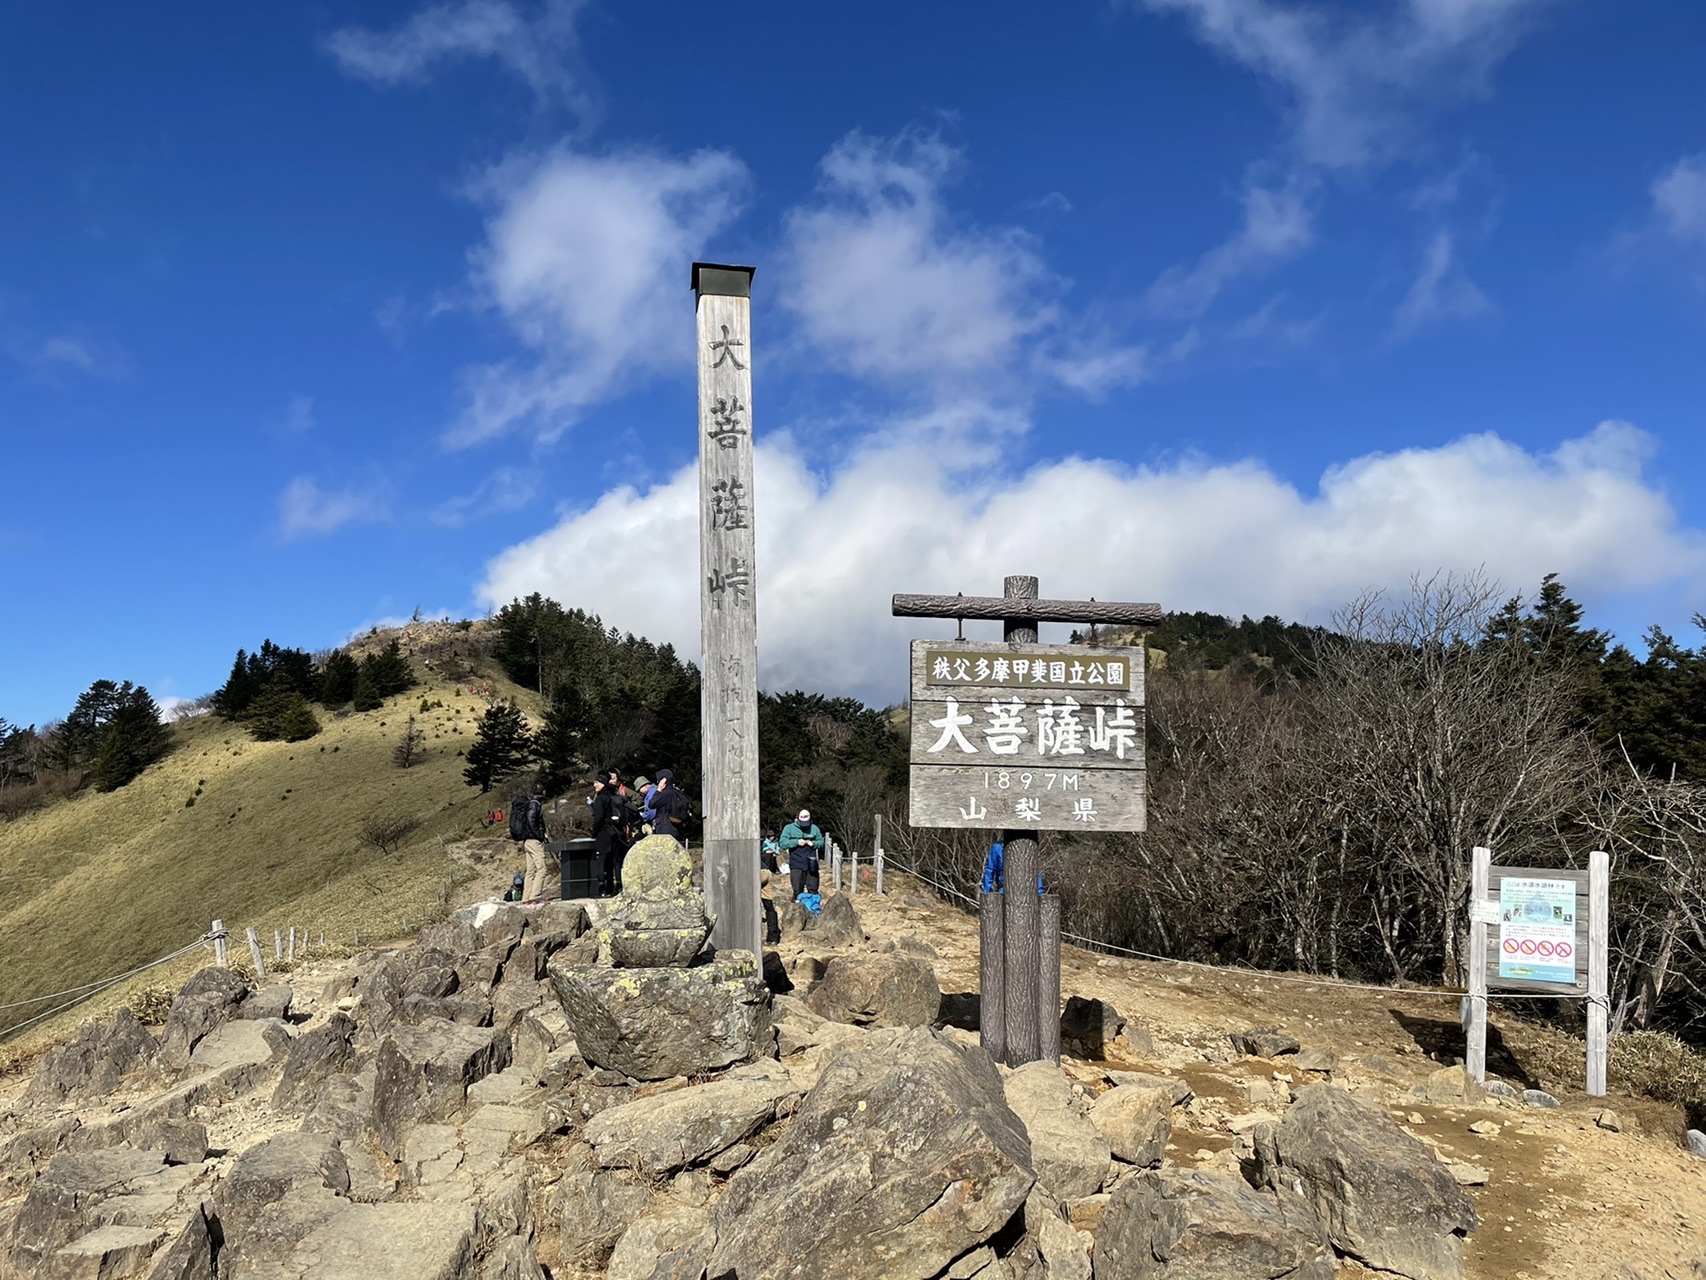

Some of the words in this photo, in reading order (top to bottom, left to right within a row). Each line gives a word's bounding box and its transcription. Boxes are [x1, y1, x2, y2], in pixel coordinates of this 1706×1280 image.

[708, 324, 749, 607] 大菩薩峠
[932, 656, 1124, 685] 秩父多摩甲斐国立公園
[926, 695, 1137, 760] 大菩薩峠
[983, 772, 1080, 791] 1897M
[959, 797, 1098, 822] 山梨県
